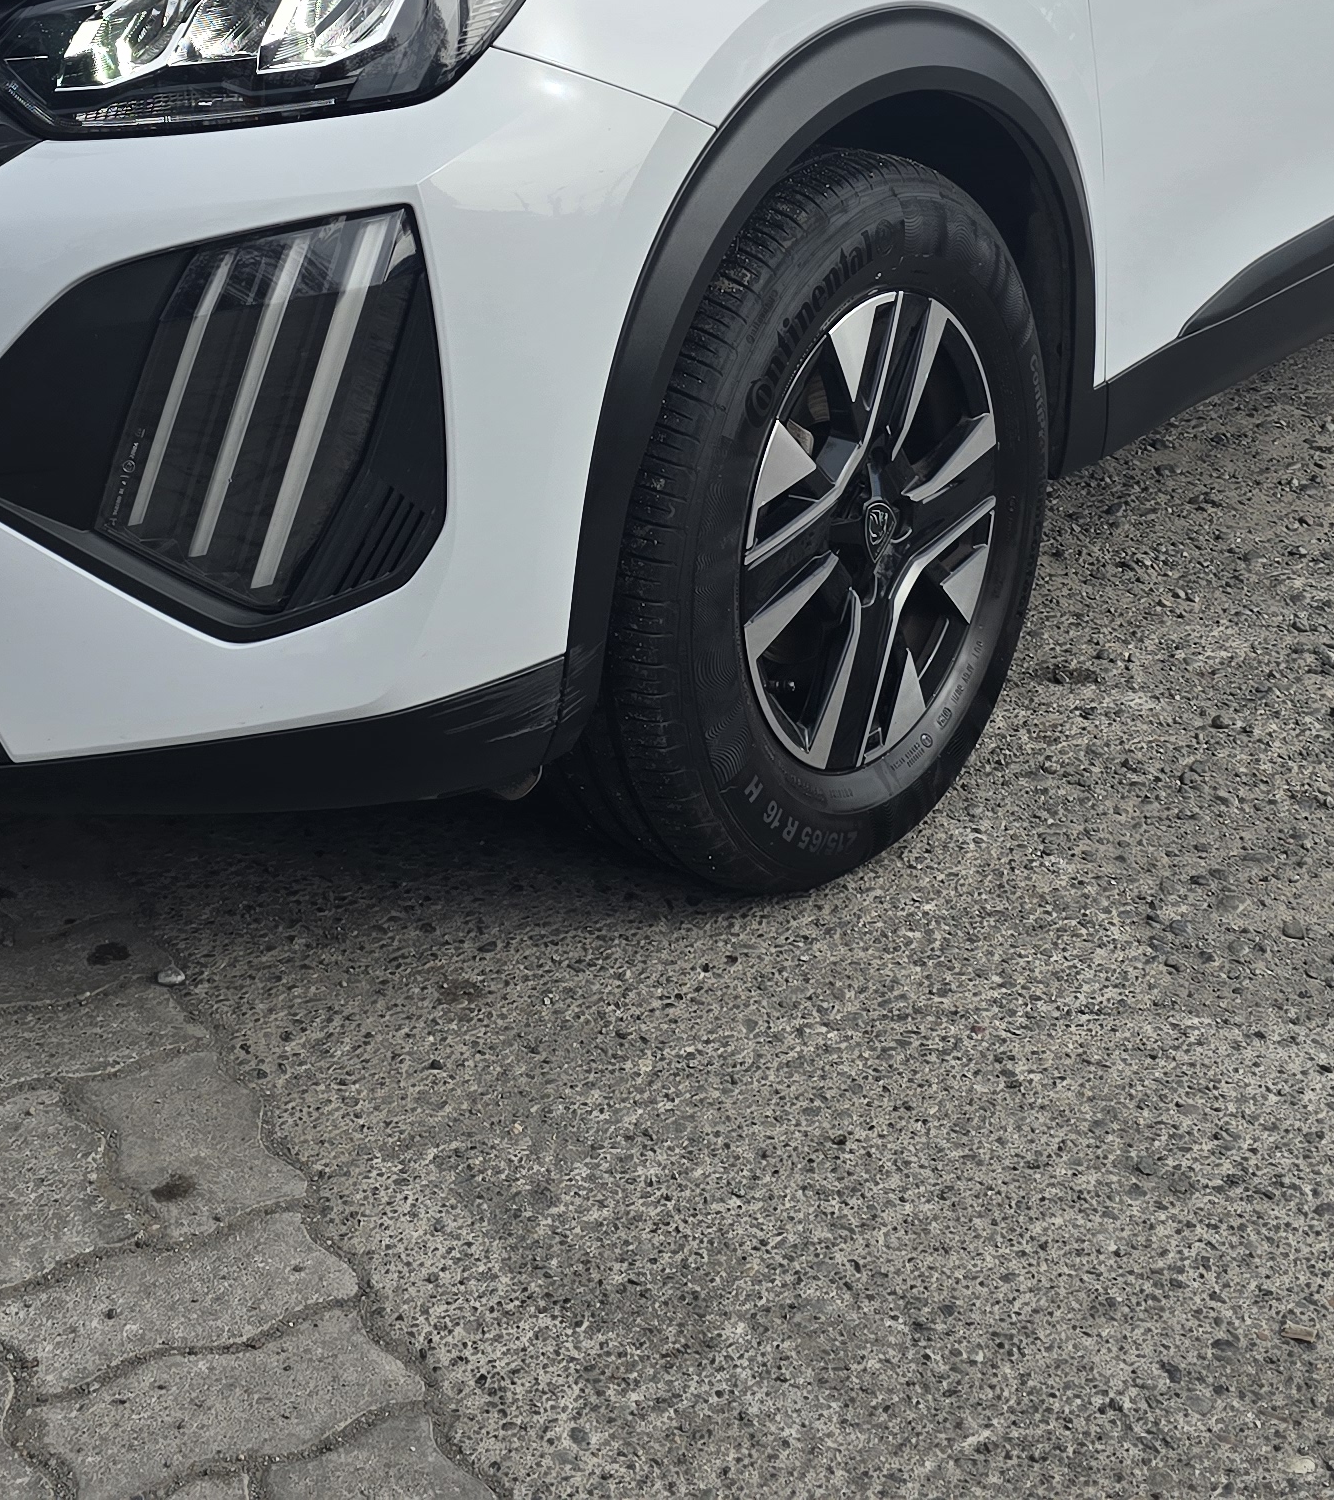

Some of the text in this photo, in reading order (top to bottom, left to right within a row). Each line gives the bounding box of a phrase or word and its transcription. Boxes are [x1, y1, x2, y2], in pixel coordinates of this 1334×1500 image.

[745, 227, 875, 428] Continental
[743, 774, 764, 803] H
[762, 800, 783, 830] 16
[782, 816, 800, 842] R
